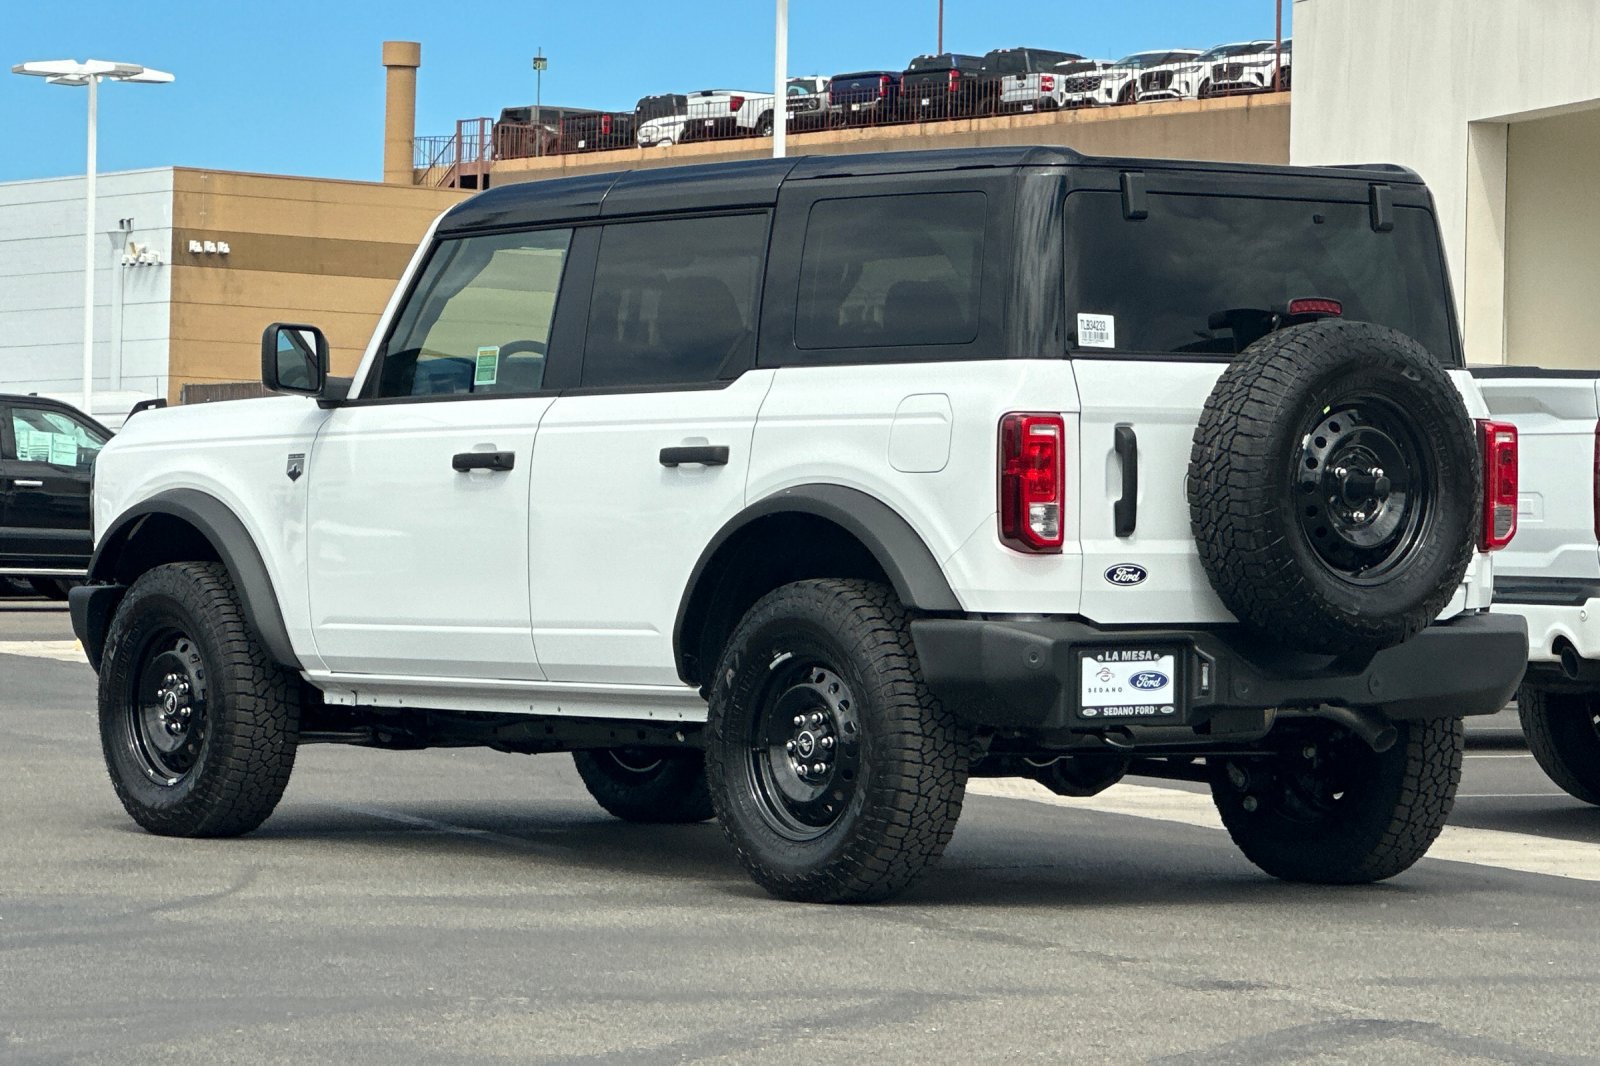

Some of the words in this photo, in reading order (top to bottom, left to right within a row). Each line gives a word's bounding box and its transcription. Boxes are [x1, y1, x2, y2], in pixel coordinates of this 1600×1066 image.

[1113, 567, 1141, 582] Ford
[1105, 651, 1119, 661] LA
[1121, 650, 1152, 661] MESA
[1136, 673, 1161, 688] Ford
[1103, 706, 1133, 716] SEDANO
[1134, 705, 1155, 715] FORD
